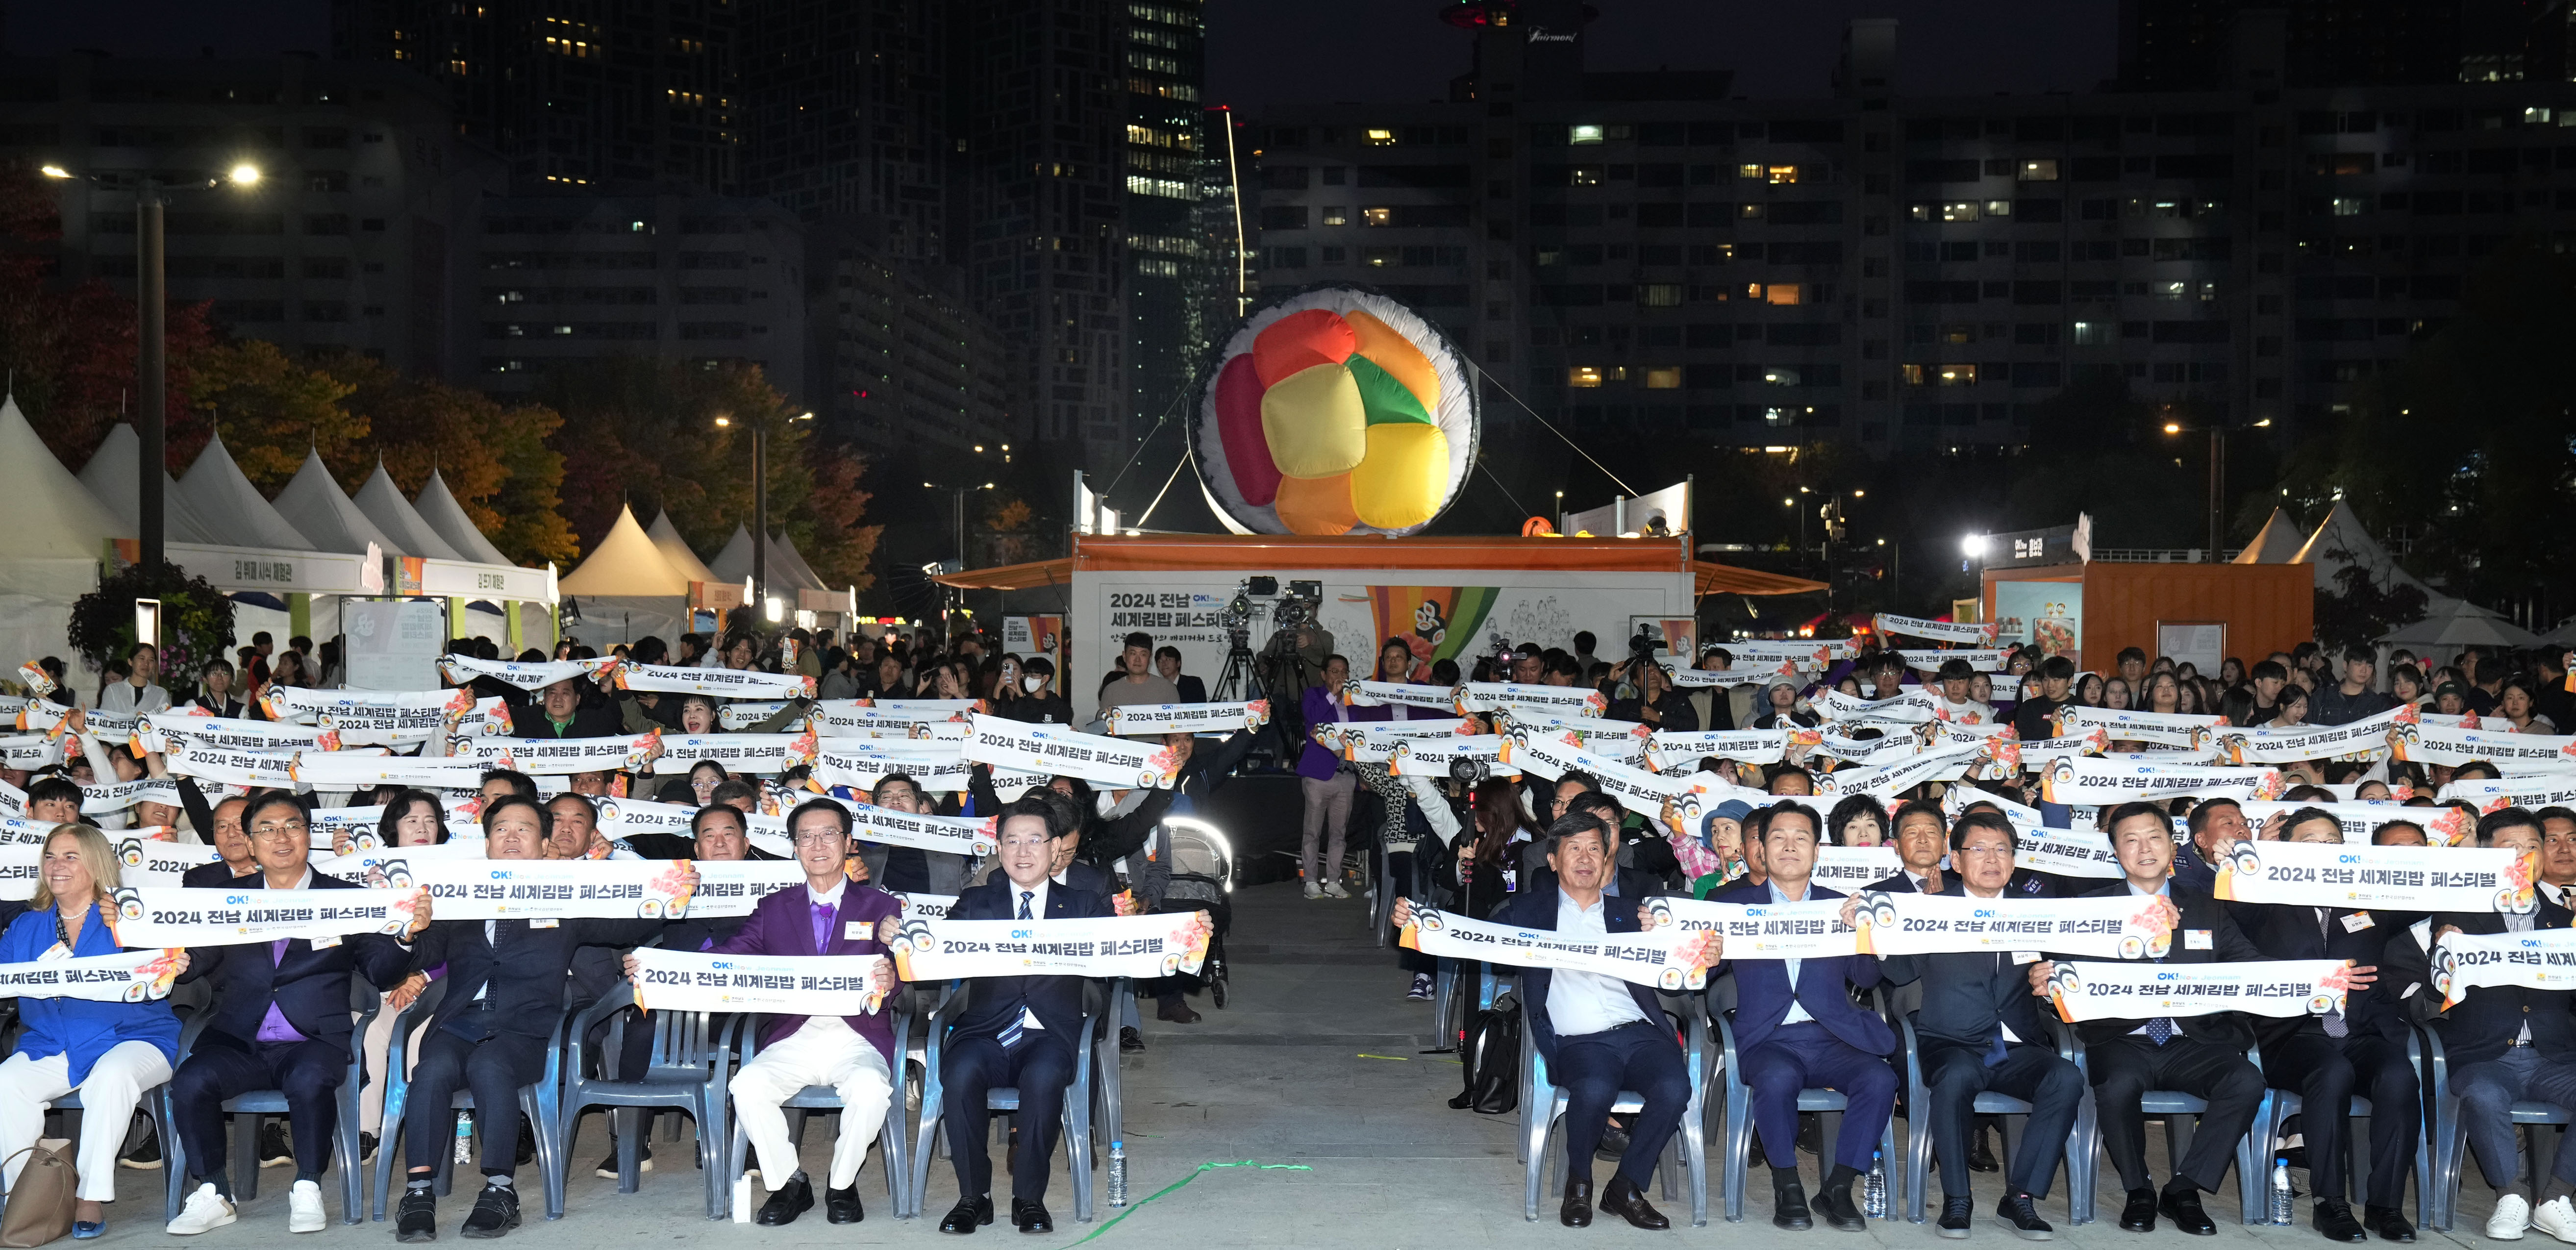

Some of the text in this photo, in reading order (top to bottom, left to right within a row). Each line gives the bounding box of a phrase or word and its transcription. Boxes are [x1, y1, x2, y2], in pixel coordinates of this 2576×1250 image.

[1528, 26, 1577, 43] Fairmont
[235, 561, 242, 579] 김
[1111, 594, 1190, 608] 2024 전남
[1111, 613, 1172, 627] 세계김밥
[1925, 621, 1951, 631] 세계김밥
[1953, 625, 1980, 634] 페스티벌
[648, 670, 745, 683] 2024 전남 세계김밥
[1517, 695, 1548, 703] 세계김밥
[1551, 697, 1583, 706] 페스티벌
[1127, 707, 1245, 721] 2024 전남 세계김밥 페스티벌
[339, 721, 370, 729] 2024
[829, 718, 909, 728] 2024 전남 세계김밥
[218, 735, 314, 748] 세계김밥 페스티벌
[2256, 721, 2390, 750] 2024 전남 세계김밥 페스티벌
[513, 746, 628, 758] 전남 세계김밥 페스티벌
[980, 733, 1143, 768] 2024 전남 세계김밥 페스티벌
[1718, 741, 1758, 751] 세계김밥
[1874, 736, 1913, 755] 페스티벌
[2425, 741, 2558, 758] 2024 전남 세계김밥 페스티벌
[190, 751, 256, 769] 2024 전남
[676, 748, 784, 759] 전남 세계김밥 페스티벌
[1530, 749, 1560, 767] 2024
[856, 761, 879, 773] 전남
[1577, 757, 1591, 766] OK!
[1842, 775, 1890, 795] 2024 전남
[2079, 776, 2258, 788] 2024 전남 세계김밥 페스티벌
[625, 813, 663, 824] 2024
[873, 816, 974, 840] 세계김밥 페스티벌
[2031, 829, 2047, 838] OK!
[2039, 842, 2090, 860] 세계김밥
[149, 860, 190, 871] 2024
[2339, 855, 2361, 864] OK!
[491, 871, 512, 879] OK!
[1817, 866, 1870, 878] 세계김밥
[2268, 866, 2496, 887] 2024 전남 세계김밥 페스티벌
[420, 884, 642, 899] 2024 전남 세계김밥 페스티벌
[226, 896, 248, 904] OK!
[152, 907, 386, 924] 2024 전남 세계김밥 페스티벌
[1974, 909, 1995, 918] OK!
[1681, 920, 1825, 936] 2024 전남 세계김밥
[1903, 918, 2122, 934] 2024 전남 세계김밥 페스티벌
[1012, 930, 1032, 938] OK!
[943, 939, 1163, 956] 2024 전남 세계김밥 페스티벌
[1451, 929, 1667, 964] 2024 전남 세계김밥 페스티벌
[2521, 939, 2541, 948] OK!
[2457, 950, 2541, 966] 2024 전남
[66, 971, 131, 983] 페스티벌
[646, 969, 863, 991] 2024 전남 세계김밥 페스티벌
[2087, 983, 2312, 997] 2024 전남 세계김밥 페스티벌
